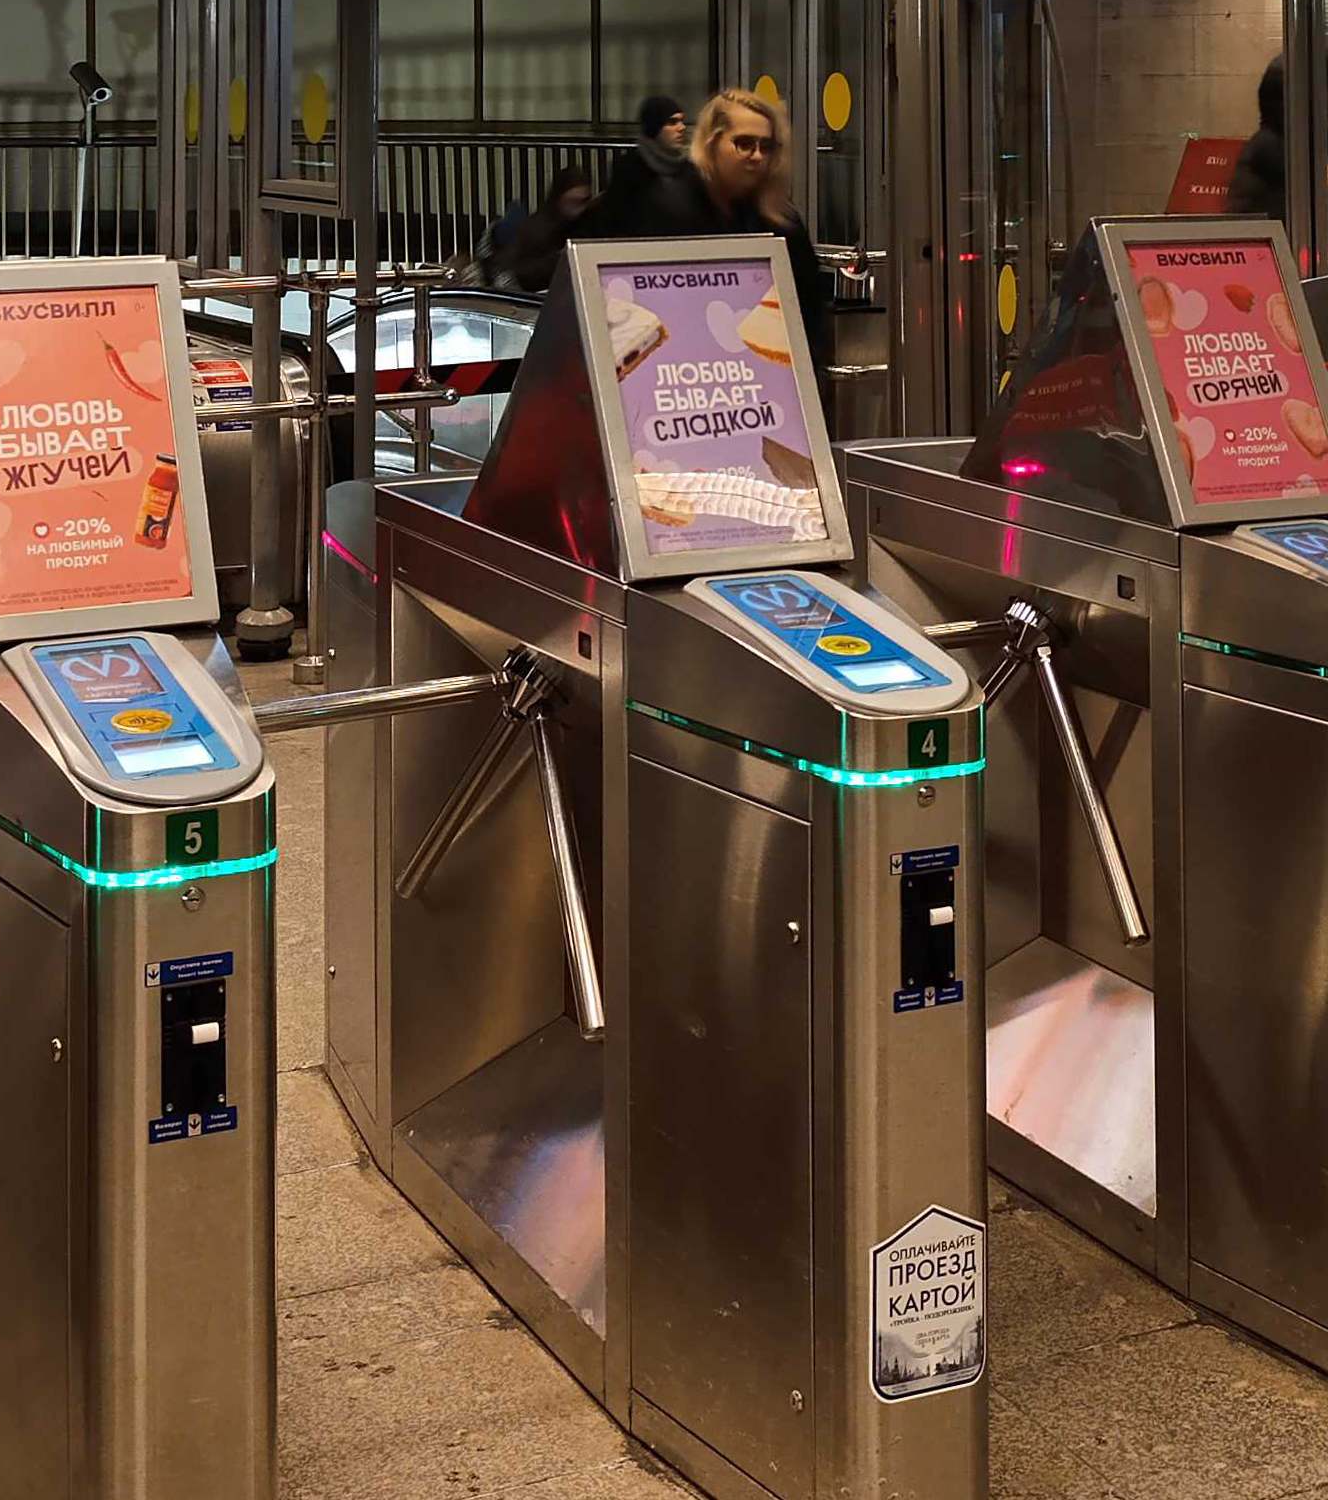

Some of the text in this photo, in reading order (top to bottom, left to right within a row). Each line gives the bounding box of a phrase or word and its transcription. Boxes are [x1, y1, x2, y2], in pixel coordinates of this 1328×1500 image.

[1156, 251, 1247, 267] ВКУСВИЛЛ
[633, 271, 739, 290] ВКУСВИЛЛ
[1183, 331, 1268, 355] ЛЮБОВЬ
[656, 359, 755, 386] ЛЮБОВЬ
[0, 399, 124, 430] ЛЮБОВЬ
[1239, 427, 1278, 441] -20%
[55, 517, 112, 536] -20%
[26, 535, 124, 556] НА ЛЮБИМЫЙ
[45, 553, 109, 570] ПРОДУКТ
[921, 728, 937, 759] 4
[184, 820, 203, 855] 5
[890, 1234, 976, 1262] ОПЛАЧИВАЙТЕ
[889, 1250, 977, 1287] ПРОЕЗД
[889, 1277, 976, 1318] КАРТОЙ
